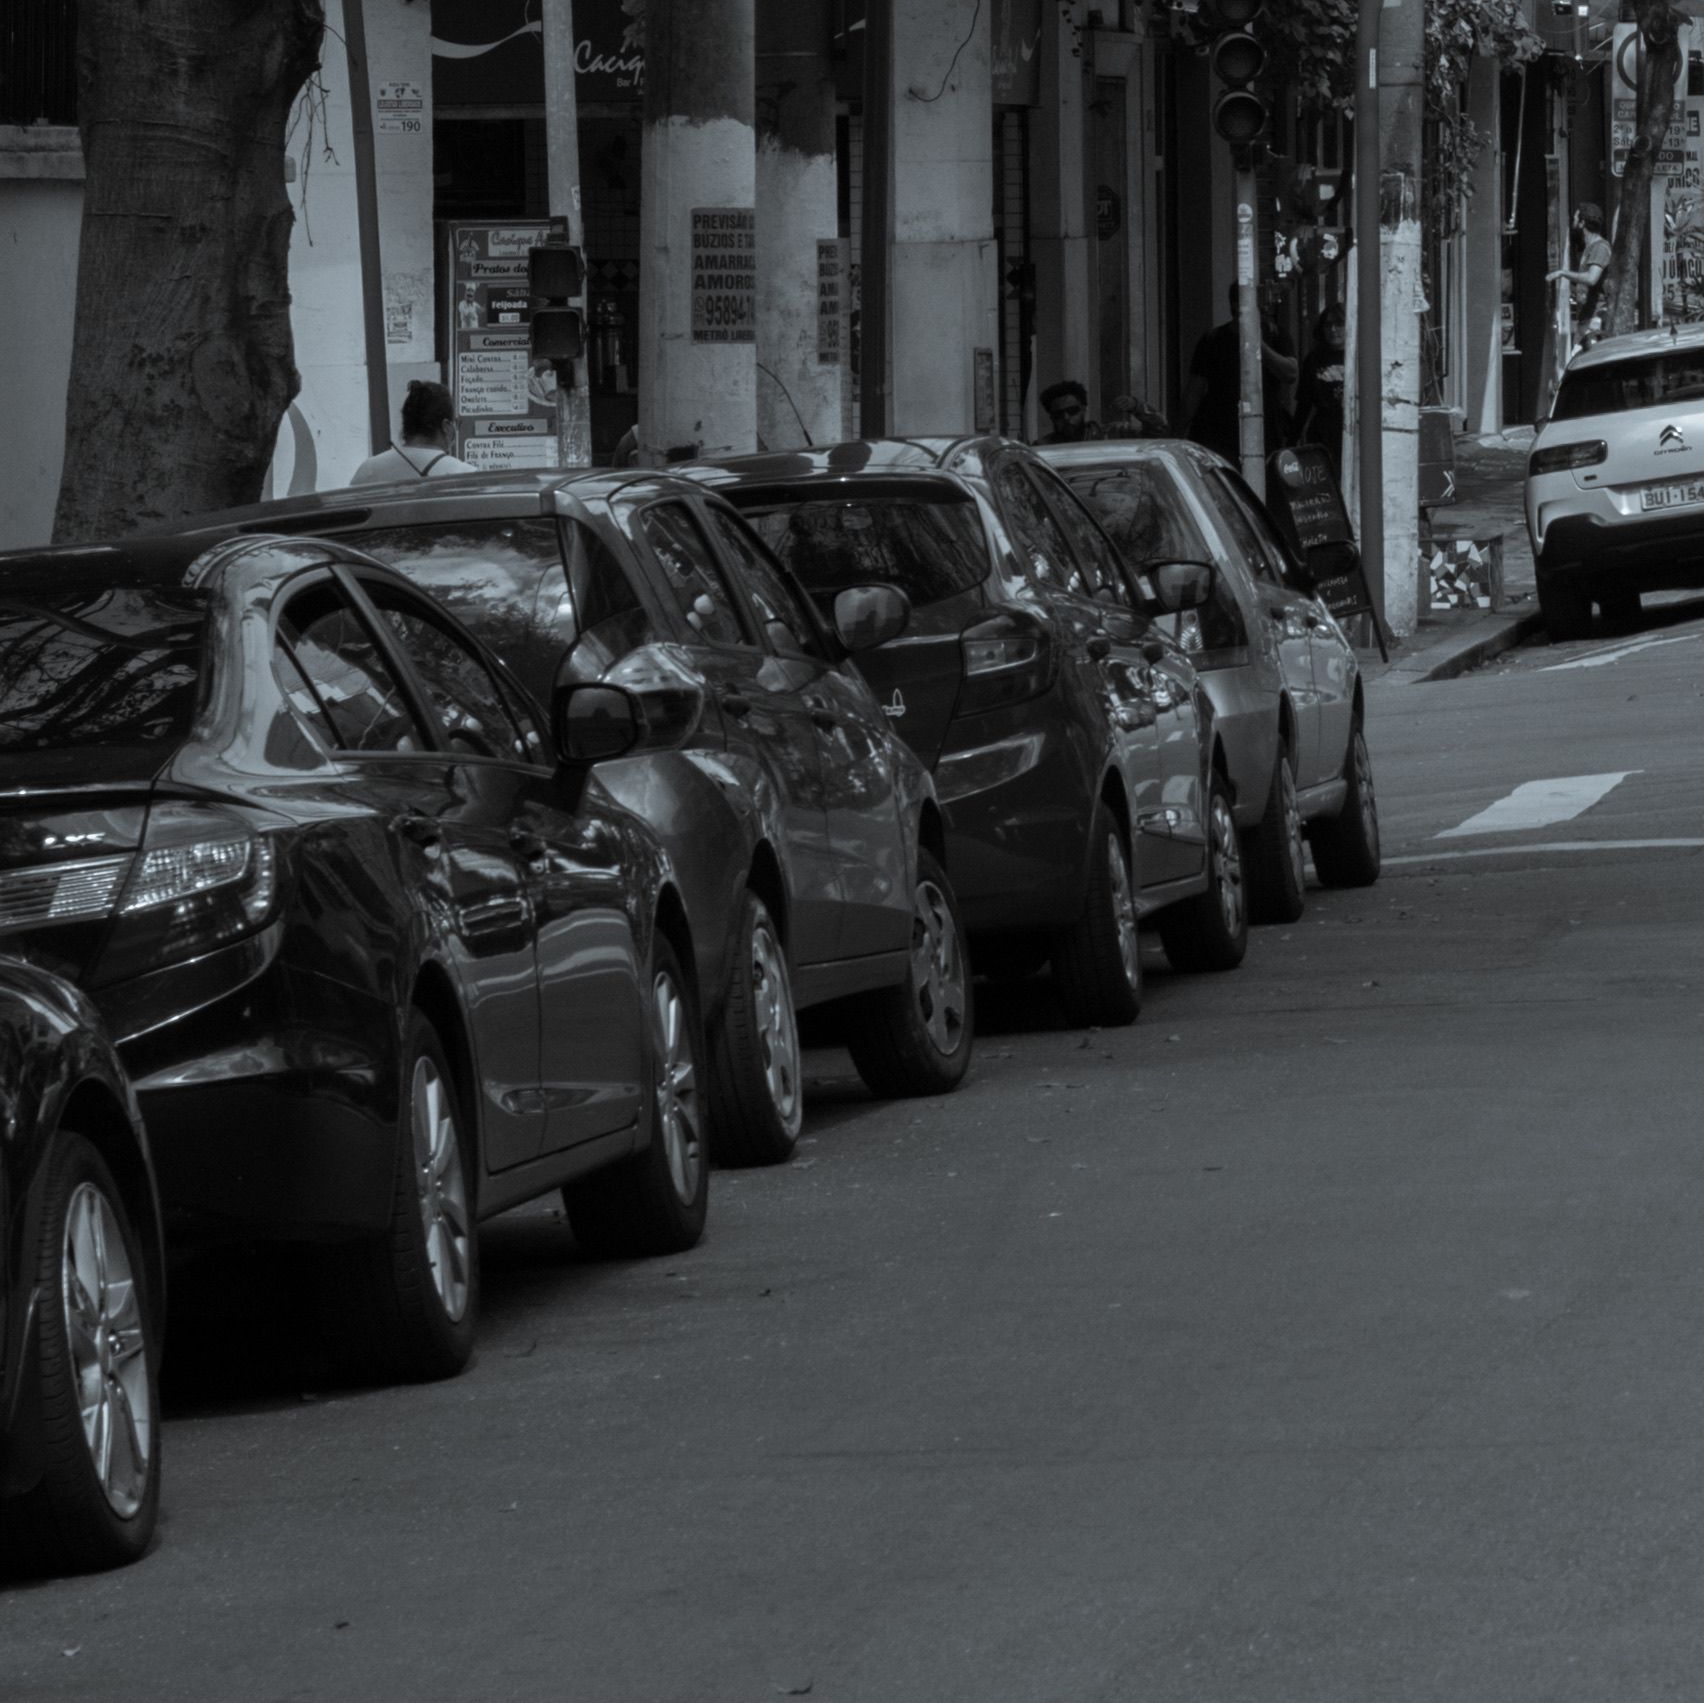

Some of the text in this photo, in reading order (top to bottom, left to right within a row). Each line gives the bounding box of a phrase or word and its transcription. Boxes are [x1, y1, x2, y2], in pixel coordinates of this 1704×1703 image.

[401, 121, 421, 132] 190
[473, 263, 510, 274] Pratos
[487, 422, 535, 434] Executivo
